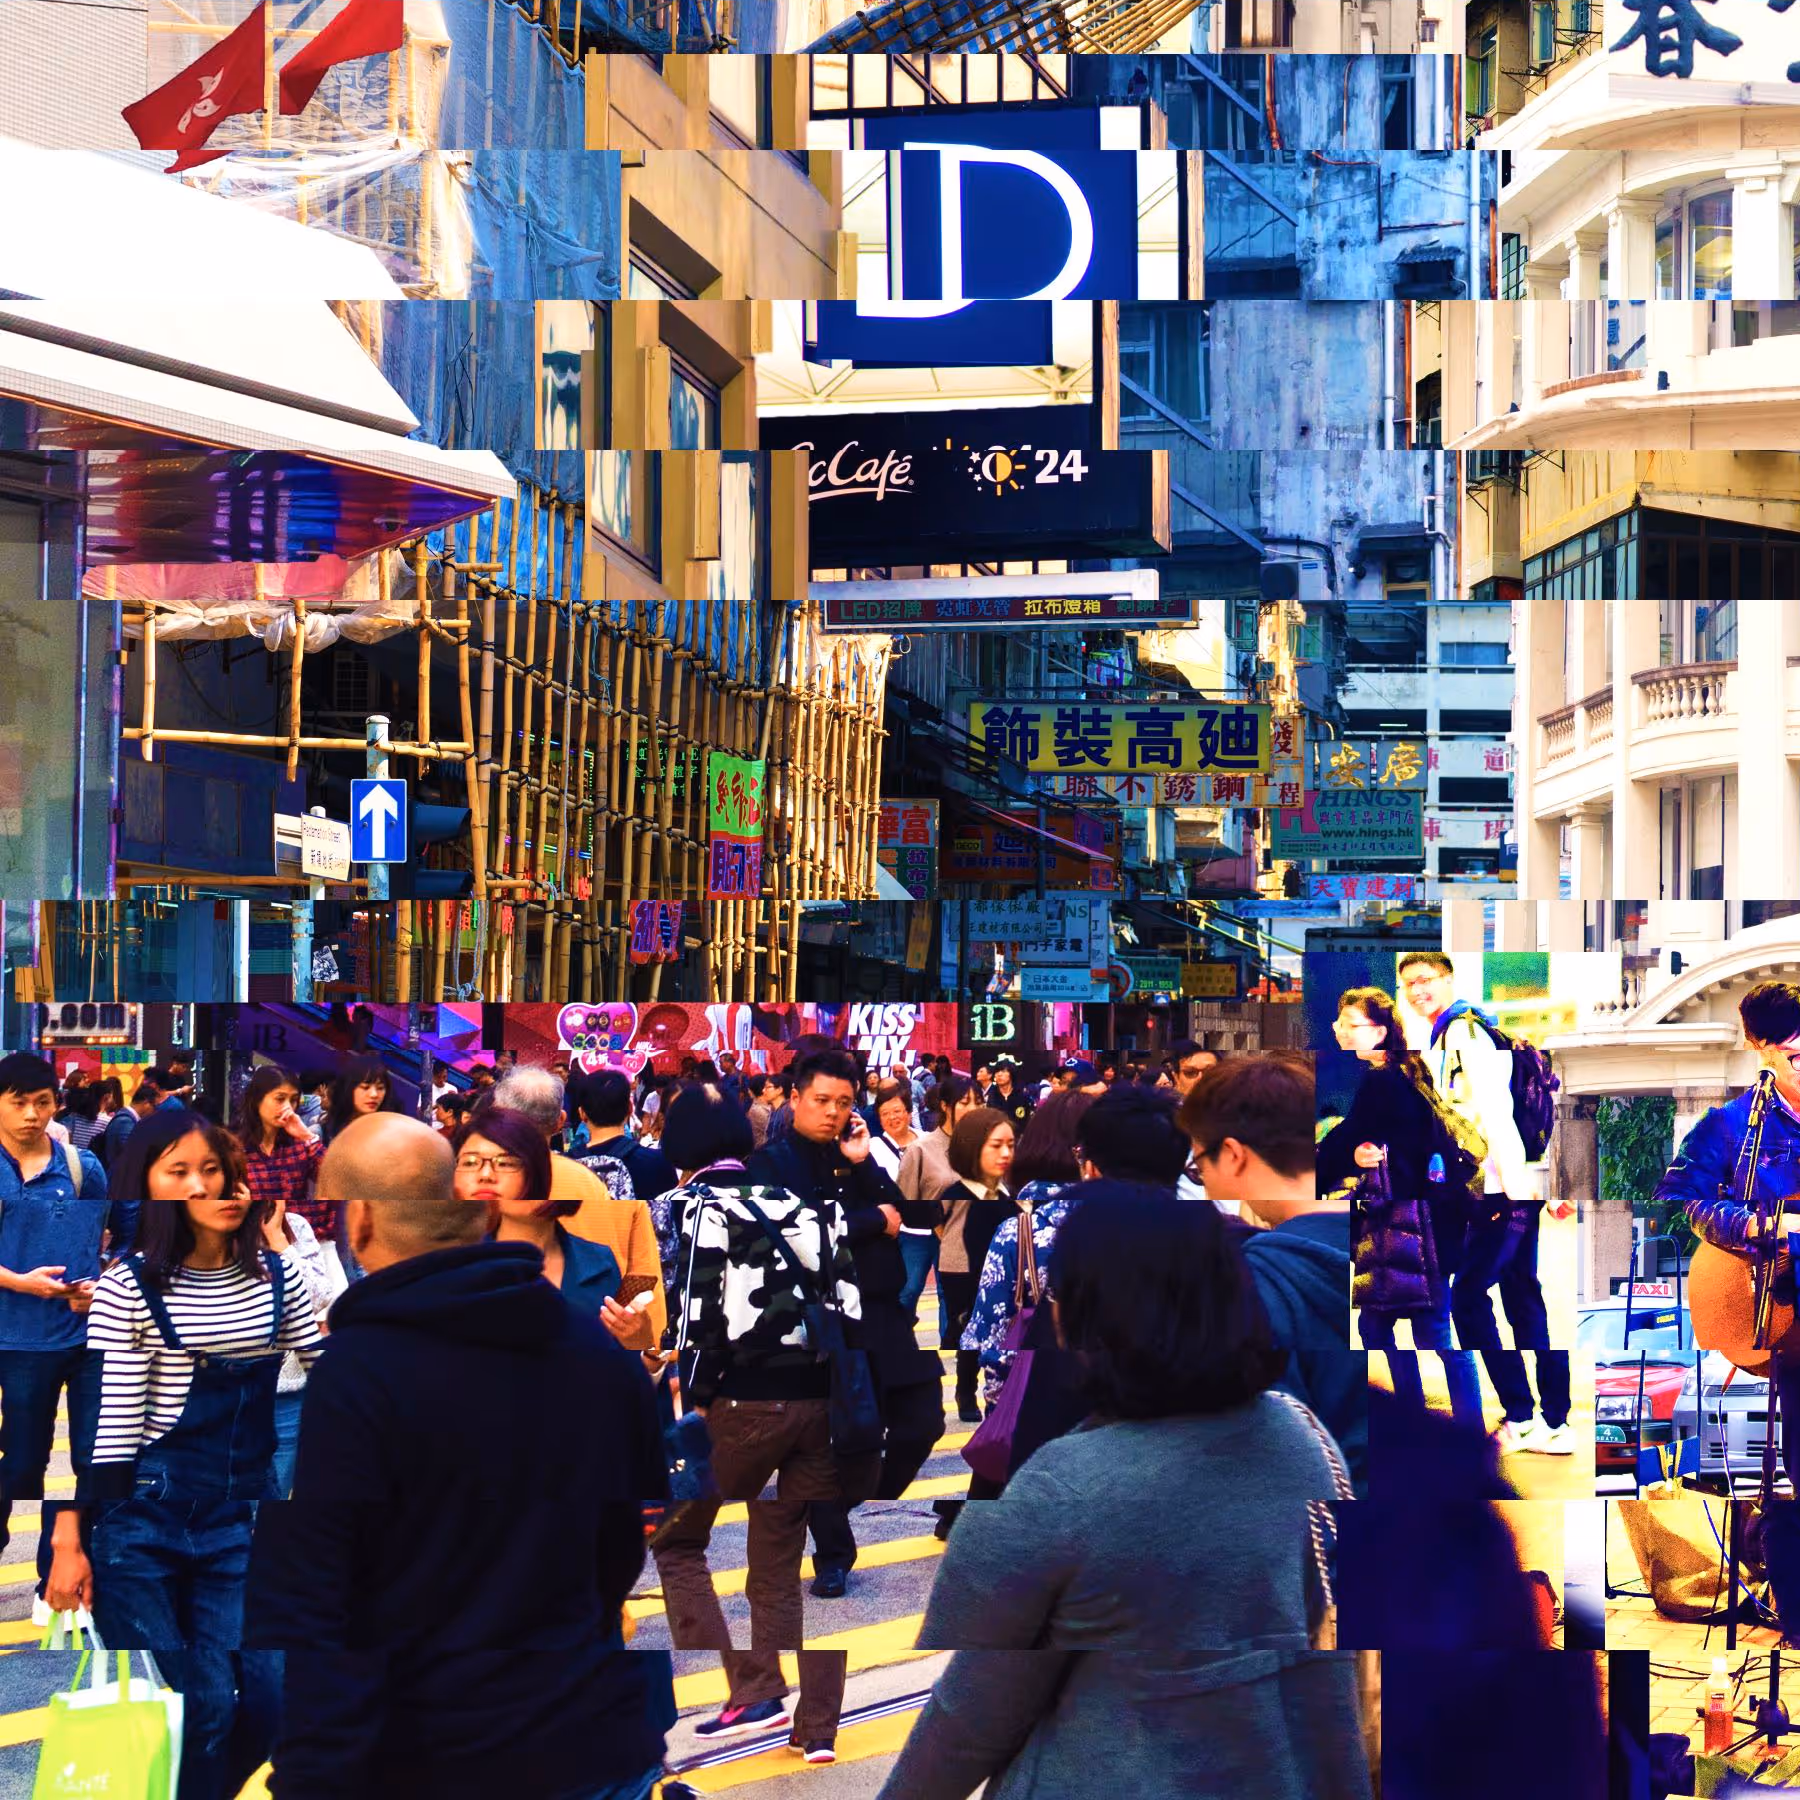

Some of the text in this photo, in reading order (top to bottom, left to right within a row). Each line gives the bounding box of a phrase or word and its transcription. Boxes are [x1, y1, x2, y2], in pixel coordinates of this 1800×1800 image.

[1321, 827, 1415, 841] www.hings.hk
[848, 1003, 917, 1035] KISS
[1630, 1284, 1669, 1295] TAXI
[1603, 1428, 1612, 1437] 4
